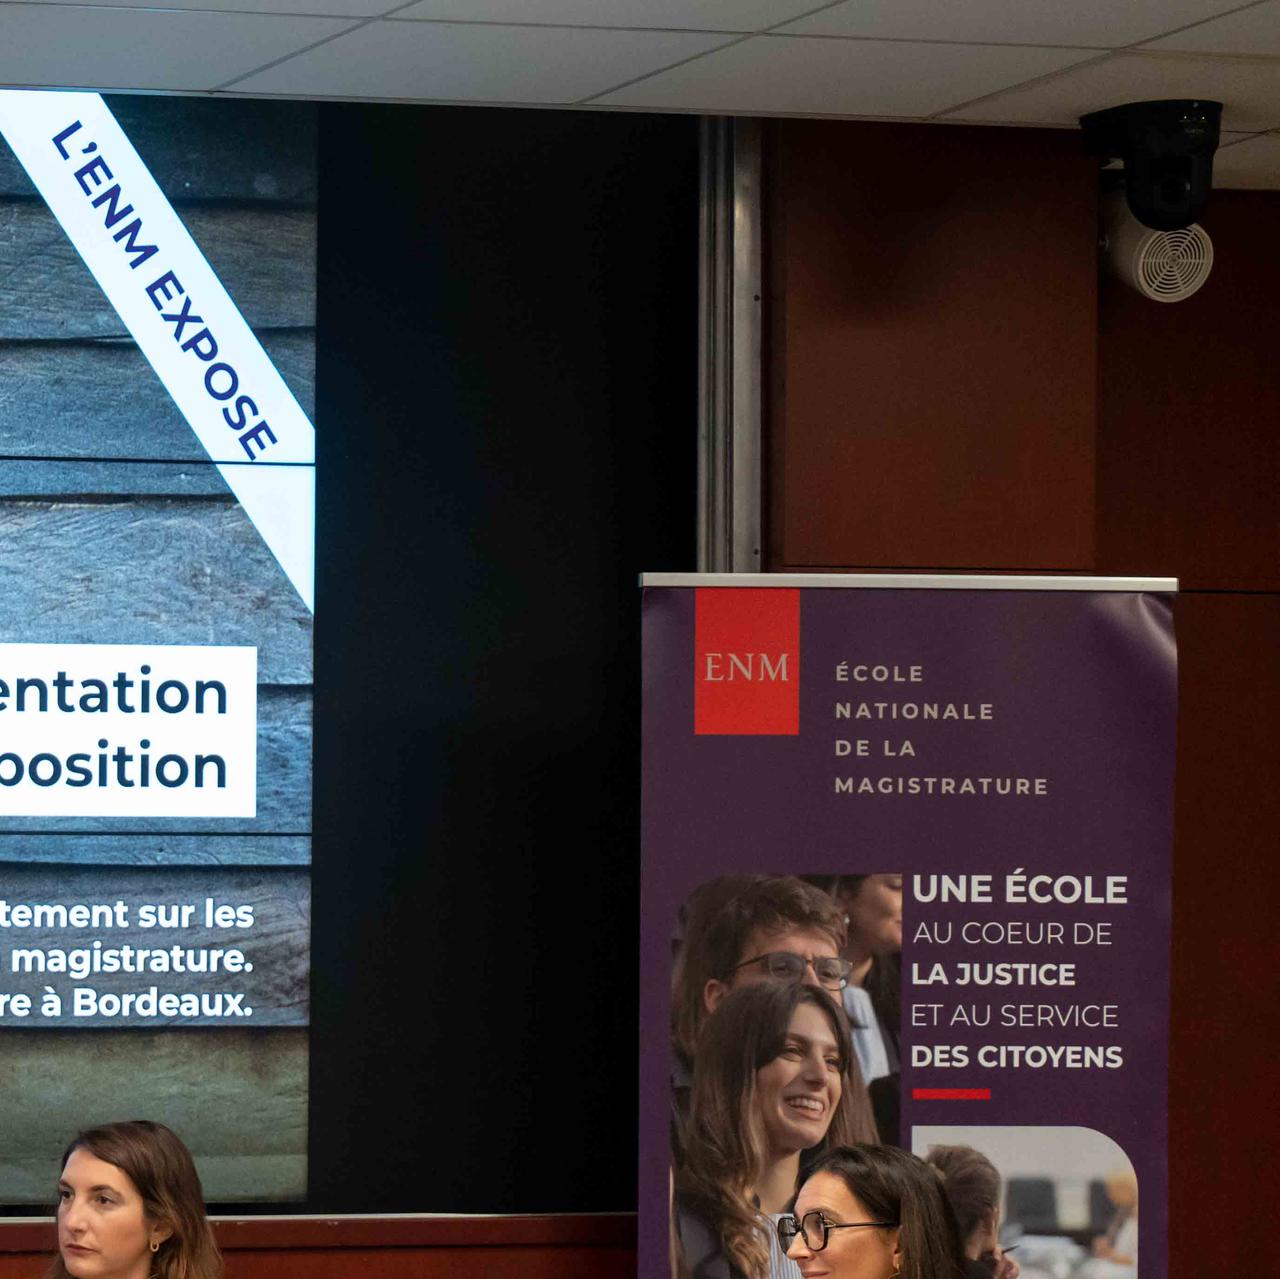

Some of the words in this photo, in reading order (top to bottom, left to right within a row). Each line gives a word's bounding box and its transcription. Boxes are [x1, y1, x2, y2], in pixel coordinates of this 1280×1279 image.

[51, 119, 160, 270] L’ENM
[144, 269, 278, 461] EXPOSE
[703, 653, 790, 682] ENM
[834, 661, 924, 683] ÉCOLE
[834, 702, 994, 721] NATIONALE
[834, 739, 871, 757] DE
[883, 739, 917, 757] LA
[833, 777, 1049, 796] MAGISTRATURE
[913, 874, 993, 903] UNE
[1005, 868, 1128, 904] ÉCOLE
[138, 904, 195, 929] sur
[205, 898, 254, 929] les
[913, 921, 952, 944] AU
[961, 921, 1064, 945] COEUR
[1073, 922, 1113, 945] DE
[11, 941, 253, 979] magistrature.
[912, 963, 949, 985] LA
[955, 963, 1076, 986] JUSTICE
[41, 988, 62, 1017] à
[73, 987, 253, 1017] Bordeaux.
[911, 1004, 944, 1027] ET
[950, 1004, 991, 1027] AU
[1000, 1004, 1119, 1027] SERVICE
[911, 1045, 970, 1068] DES
[977, 1045, 1124, 1069] CITOYENS
